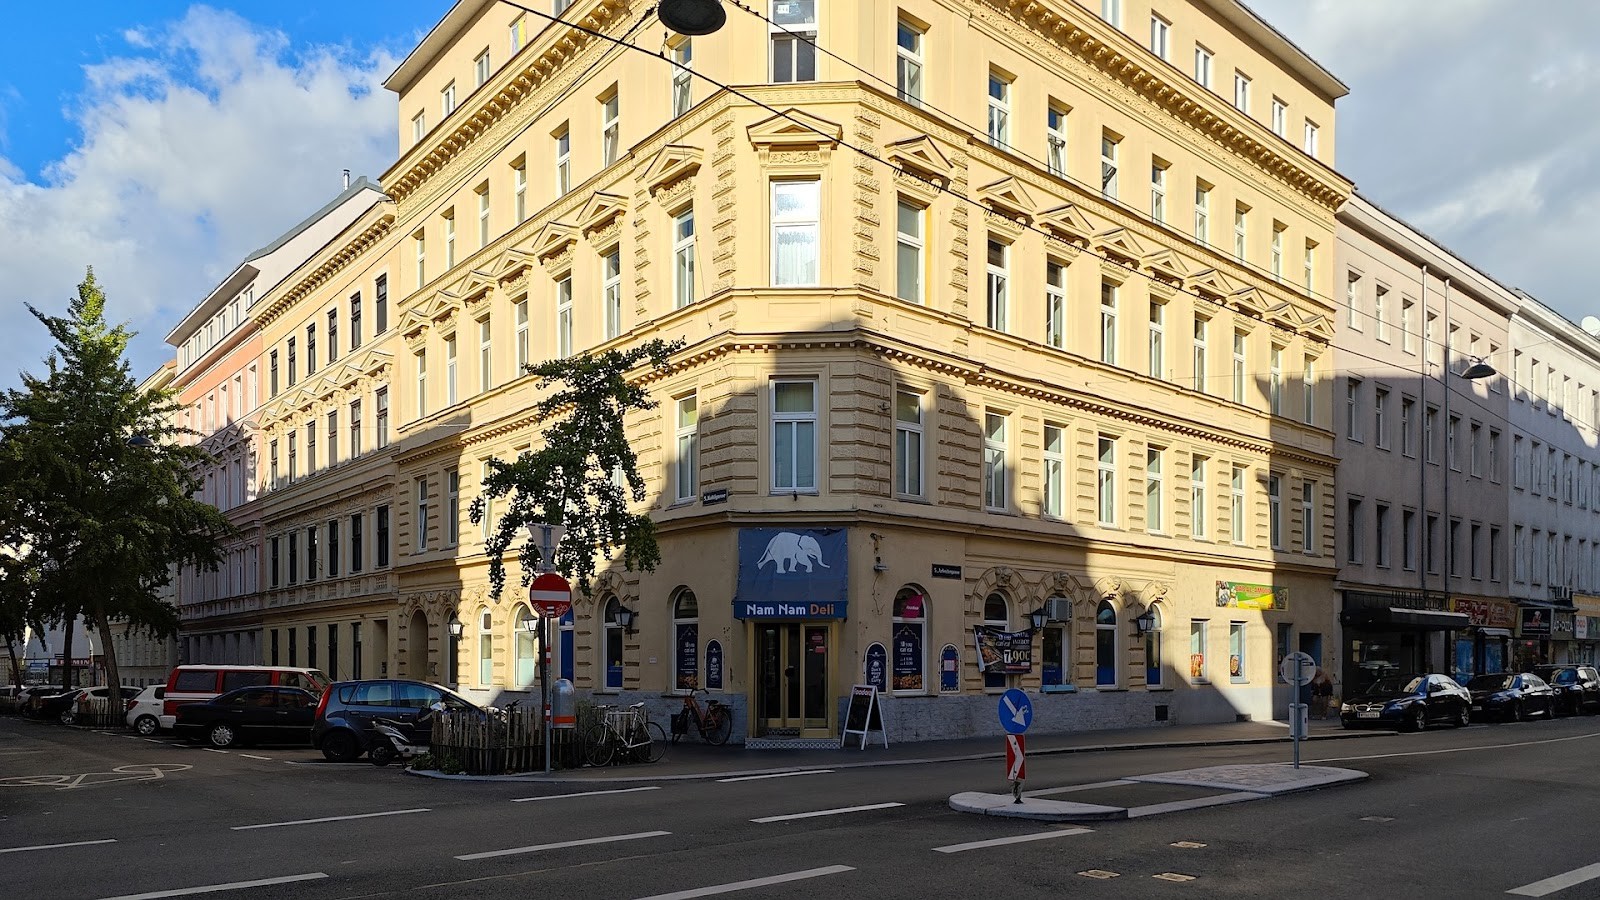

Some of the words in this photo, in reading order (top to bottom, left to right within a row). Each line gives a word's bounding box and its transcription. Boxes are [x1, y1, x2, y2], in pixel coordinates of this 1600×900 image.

[746, 603, 774, 615] Nam
[778, 603, 806, 615] Nam
[810, 603, 835, 615] Deli
